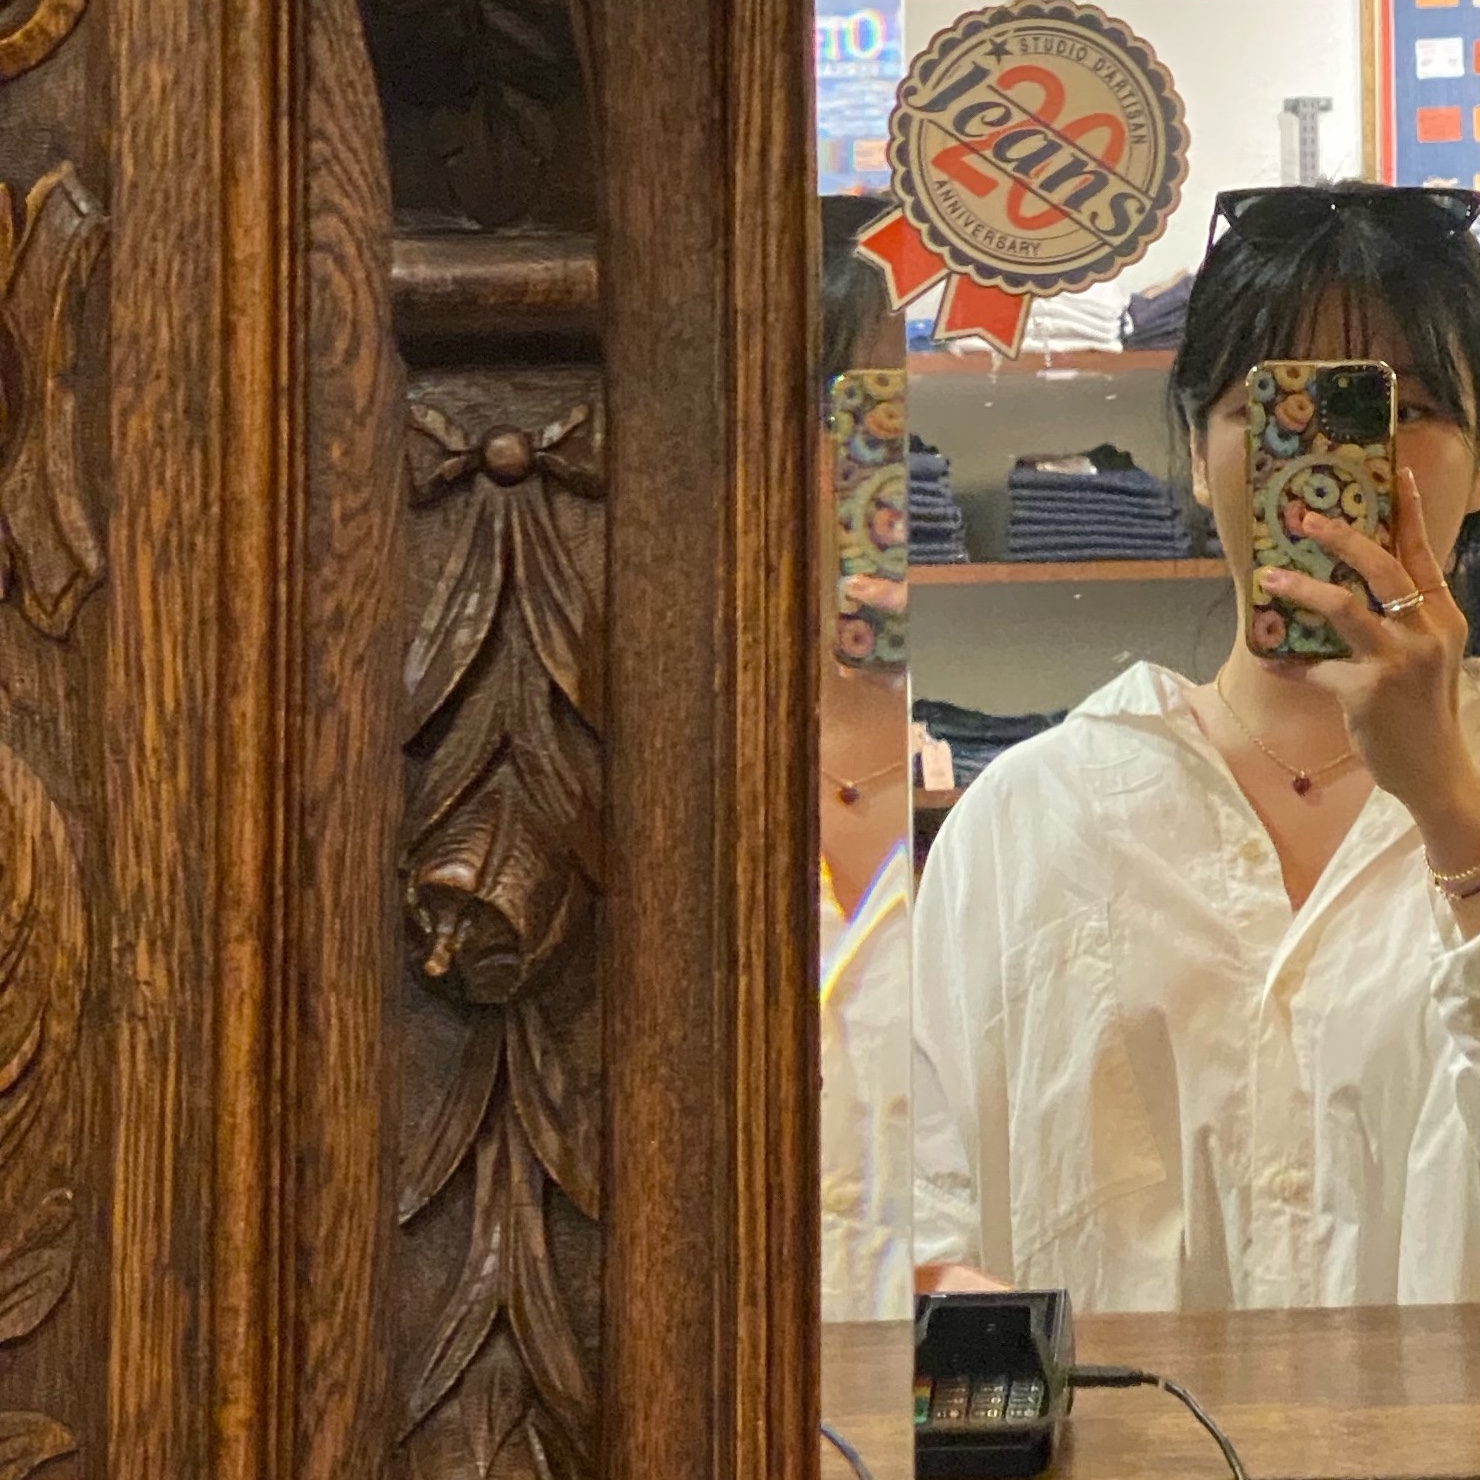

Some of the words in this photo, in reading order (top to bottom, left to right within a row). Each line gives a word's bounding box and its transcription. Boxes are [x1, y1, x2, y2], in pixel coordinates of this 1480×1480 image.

[902, 62, 1146, 237] Jeans
[931, 64, 1127, 231] 20
[1018, 36, 1090, 62] STUDIO
[1094, 51, 1149, 147] D'ARTISAN
[932, 177, 1044, 258] ANNIVERSARY
